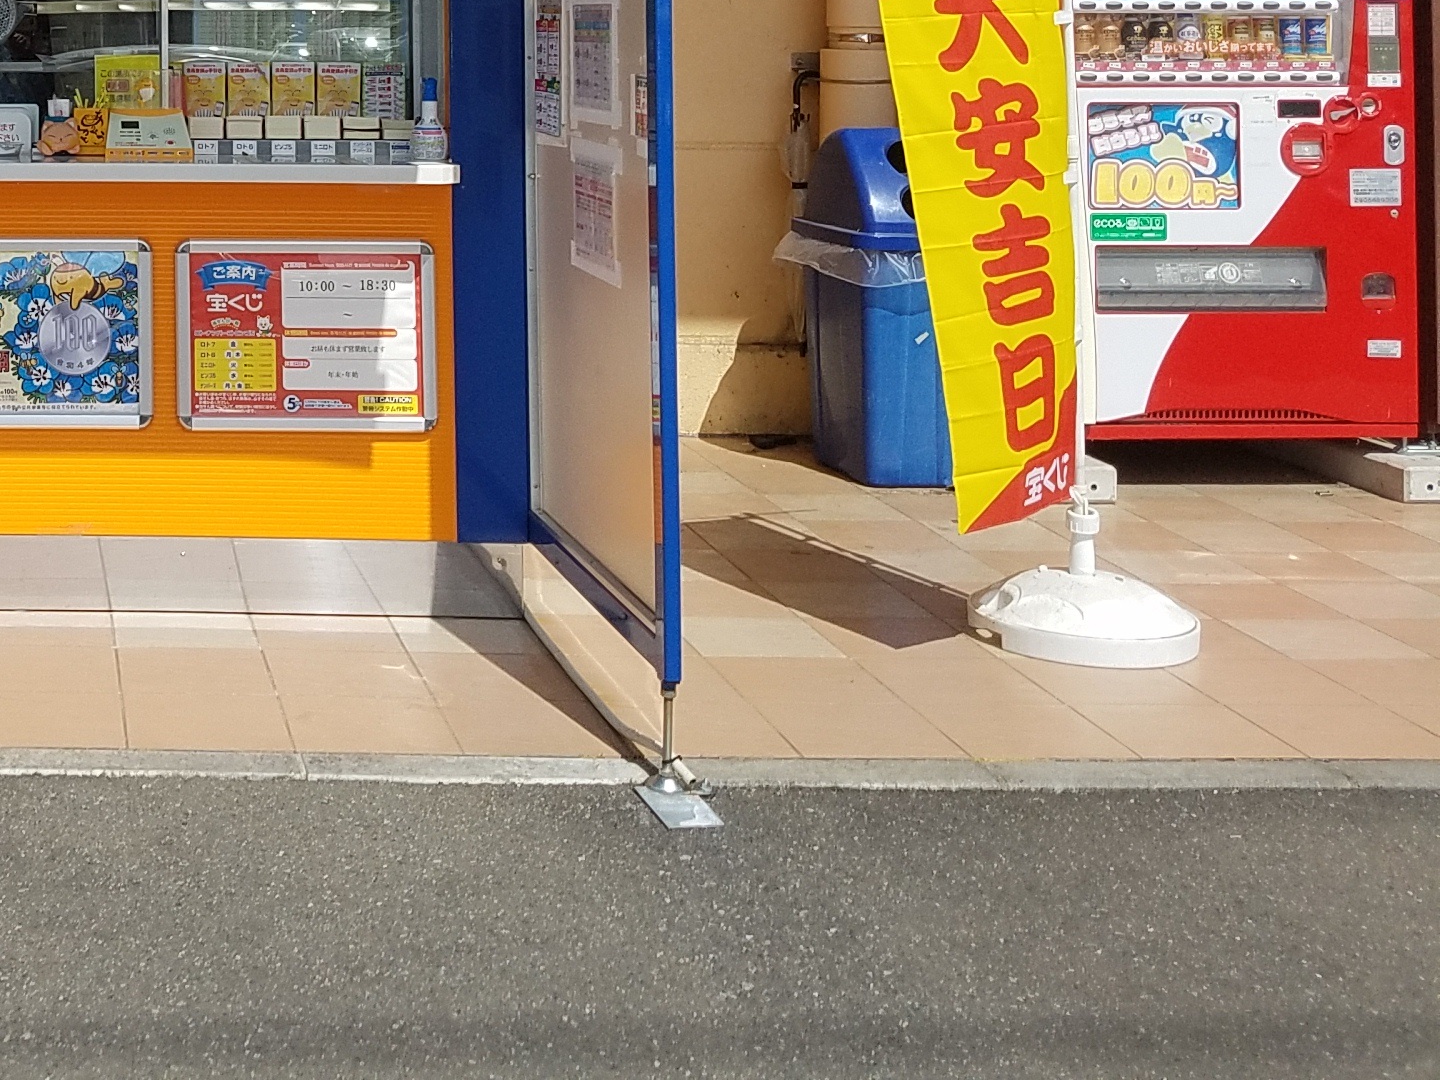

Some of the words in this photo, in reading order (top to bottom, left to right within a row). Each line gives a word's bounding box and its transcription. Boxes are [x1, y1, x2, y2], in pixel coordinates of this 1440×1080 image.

[212, 265, 256, 280] ご案内
[299, 280, 335, 292] 10:00
[360, 279, 396, 292] 18:30
[206, 293, 264, 313] 宝くじ
